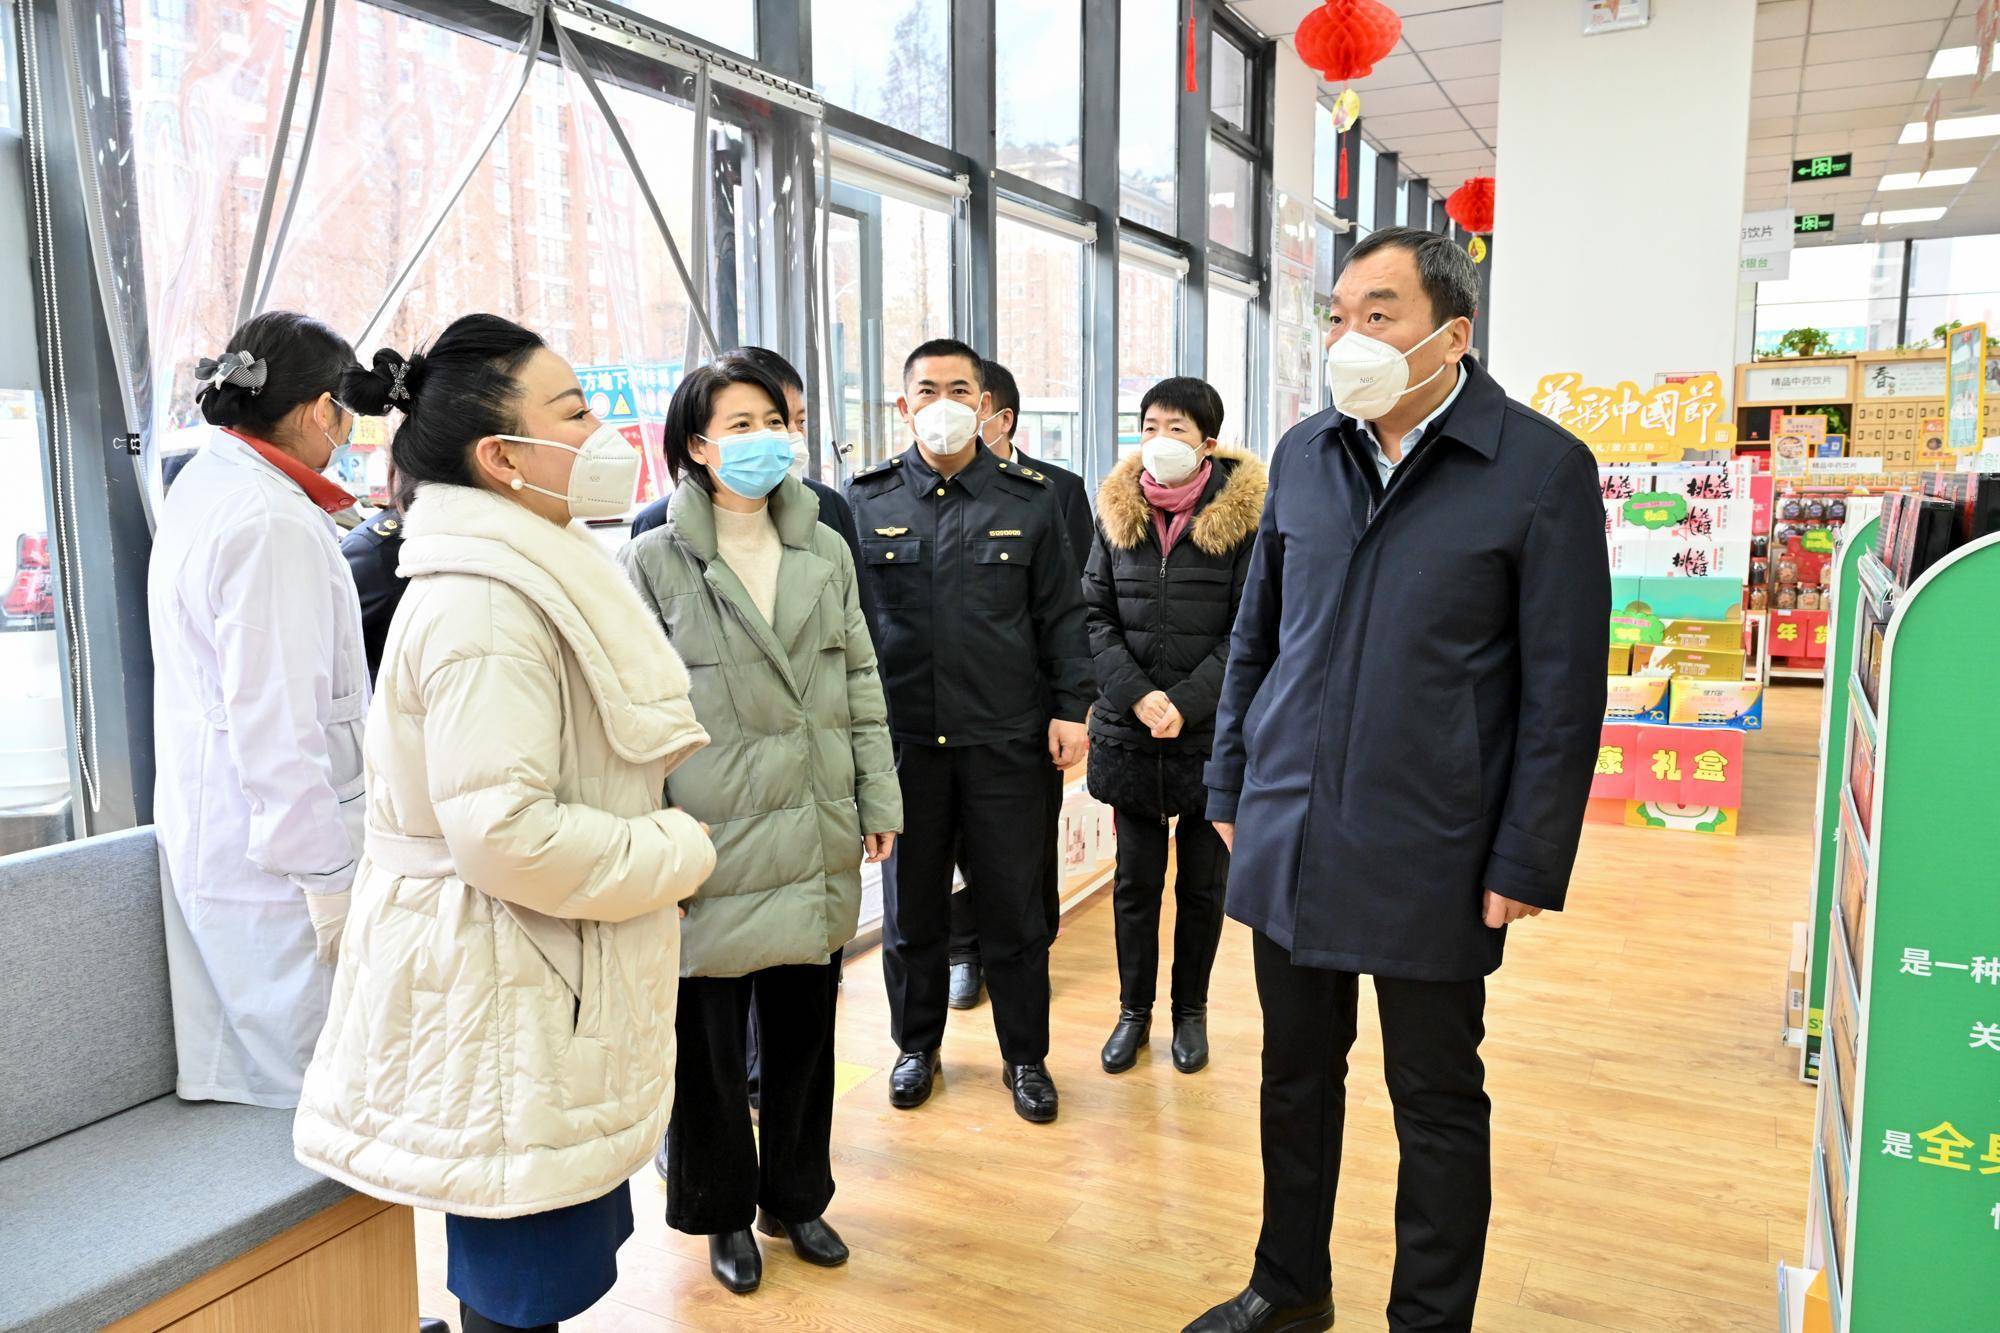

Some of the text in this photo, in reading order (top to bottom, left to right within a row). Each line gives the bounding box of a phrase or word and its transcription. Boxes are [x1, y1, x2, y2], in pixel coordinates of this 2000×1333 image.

[1771, 376, 1832, 387] 精品中药饮片
[1872, 366, 1895, 388] 春
[1672, 548, 1708, 577] 桃花姬
[1899, 947, 2000, 985] 是一种
